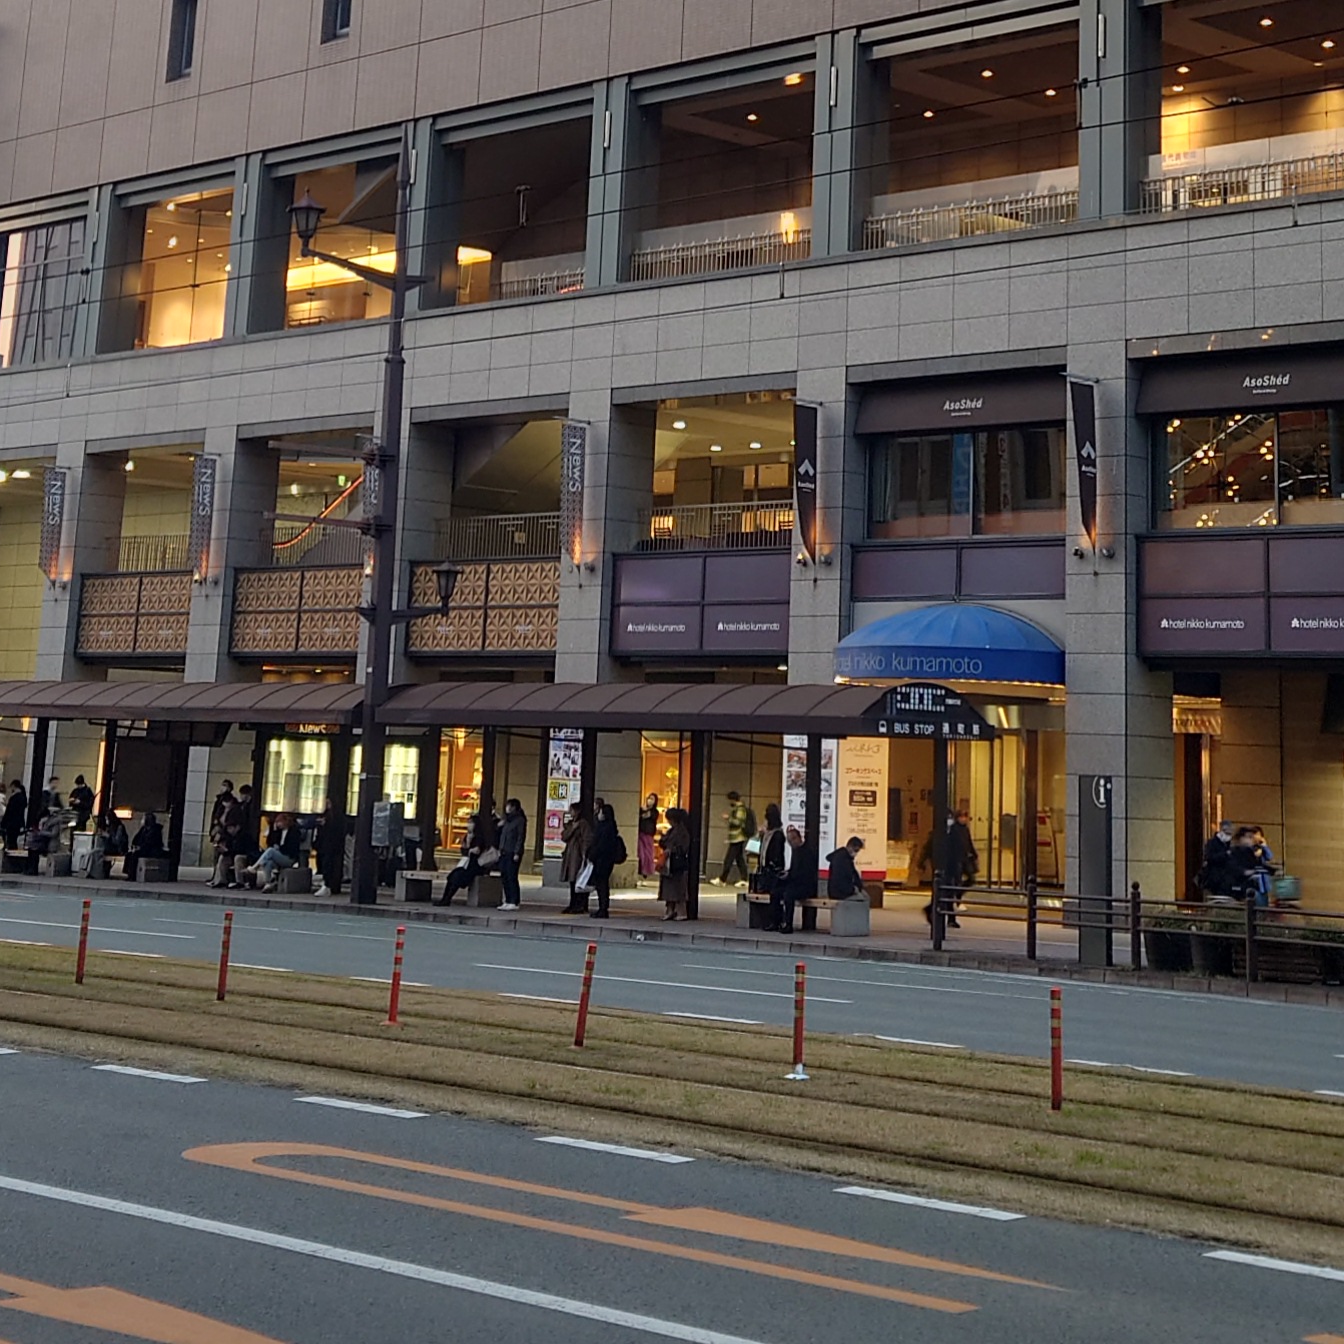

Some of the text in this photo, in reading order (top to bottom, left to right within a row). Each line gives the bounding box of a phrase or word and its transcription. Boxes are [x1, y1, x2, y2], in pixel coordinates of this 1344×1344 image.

[1169, 618, 1186, 629] hotel
[1300, 617, 1318, 629] hotel
[855, 653, 885, 671] nikko
[892, 653, 982, 674] kumamoto
[894, 722, 934, 735] BUS STOP
